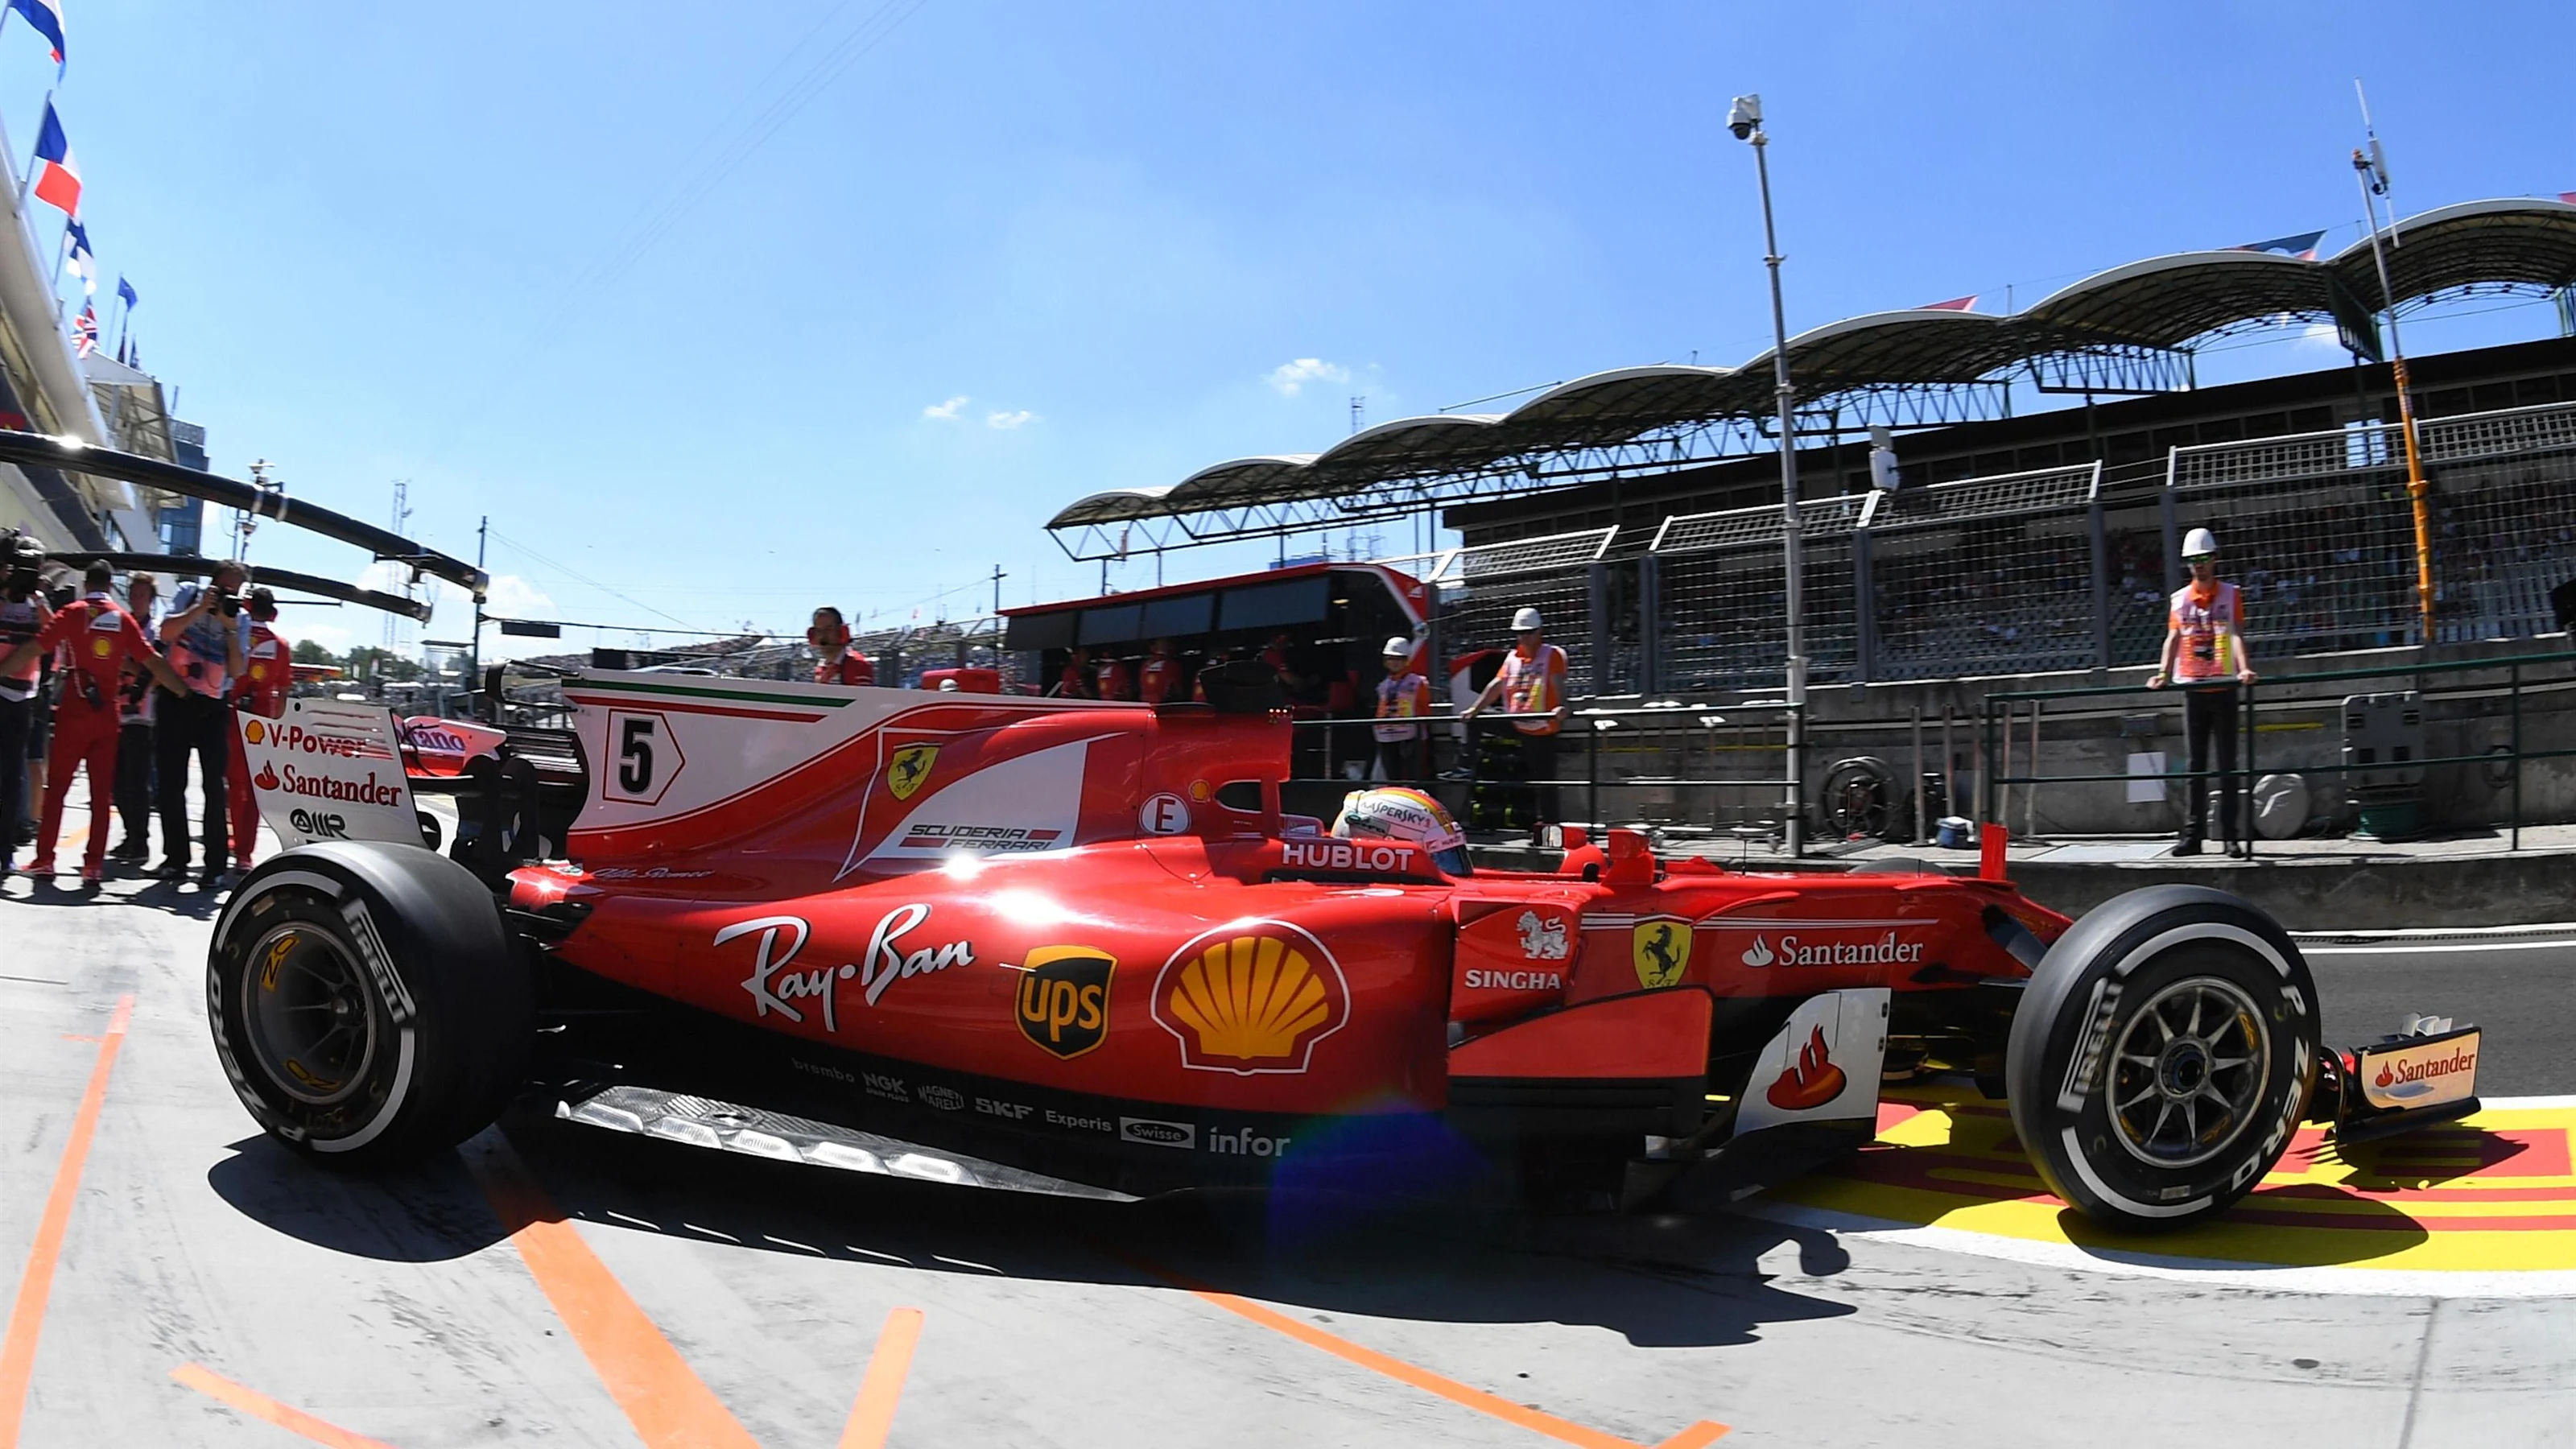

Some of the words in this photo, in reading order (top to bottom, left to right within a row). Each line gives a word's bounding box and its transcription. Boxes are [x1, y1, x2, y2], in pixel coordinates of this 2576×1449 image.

[619, 718, 654, 795] 5
[282, 764, 402, 807] Santander
[1155, 799, 1175, 832] E
[909, 825, 1026, 839] SCUDERIA
[946, 839, 1052, 850] FERRARI
[1282, 844, 1414, 871] HUBLOT
[1778, 931, 1923, 966] Santander
[1465, 970, 1561, 989] SINGHA
[2056, 976, 2124, 1114] PIRELLI
[792, 1058, 855, 1083] brembo
[2395, 1047, 2475, 1084] Santander
[862, 1071, 907, 1095] NGK
[976, 1097, 1034, 1119] SKF
[1046, 1110, 1113, 1132] Experis
[2231, 1036, 2310, 1192] ZERO
[1133, 1125, 1183, 1141] Swisse
[1209, 1126, 1291, 1157] infor
